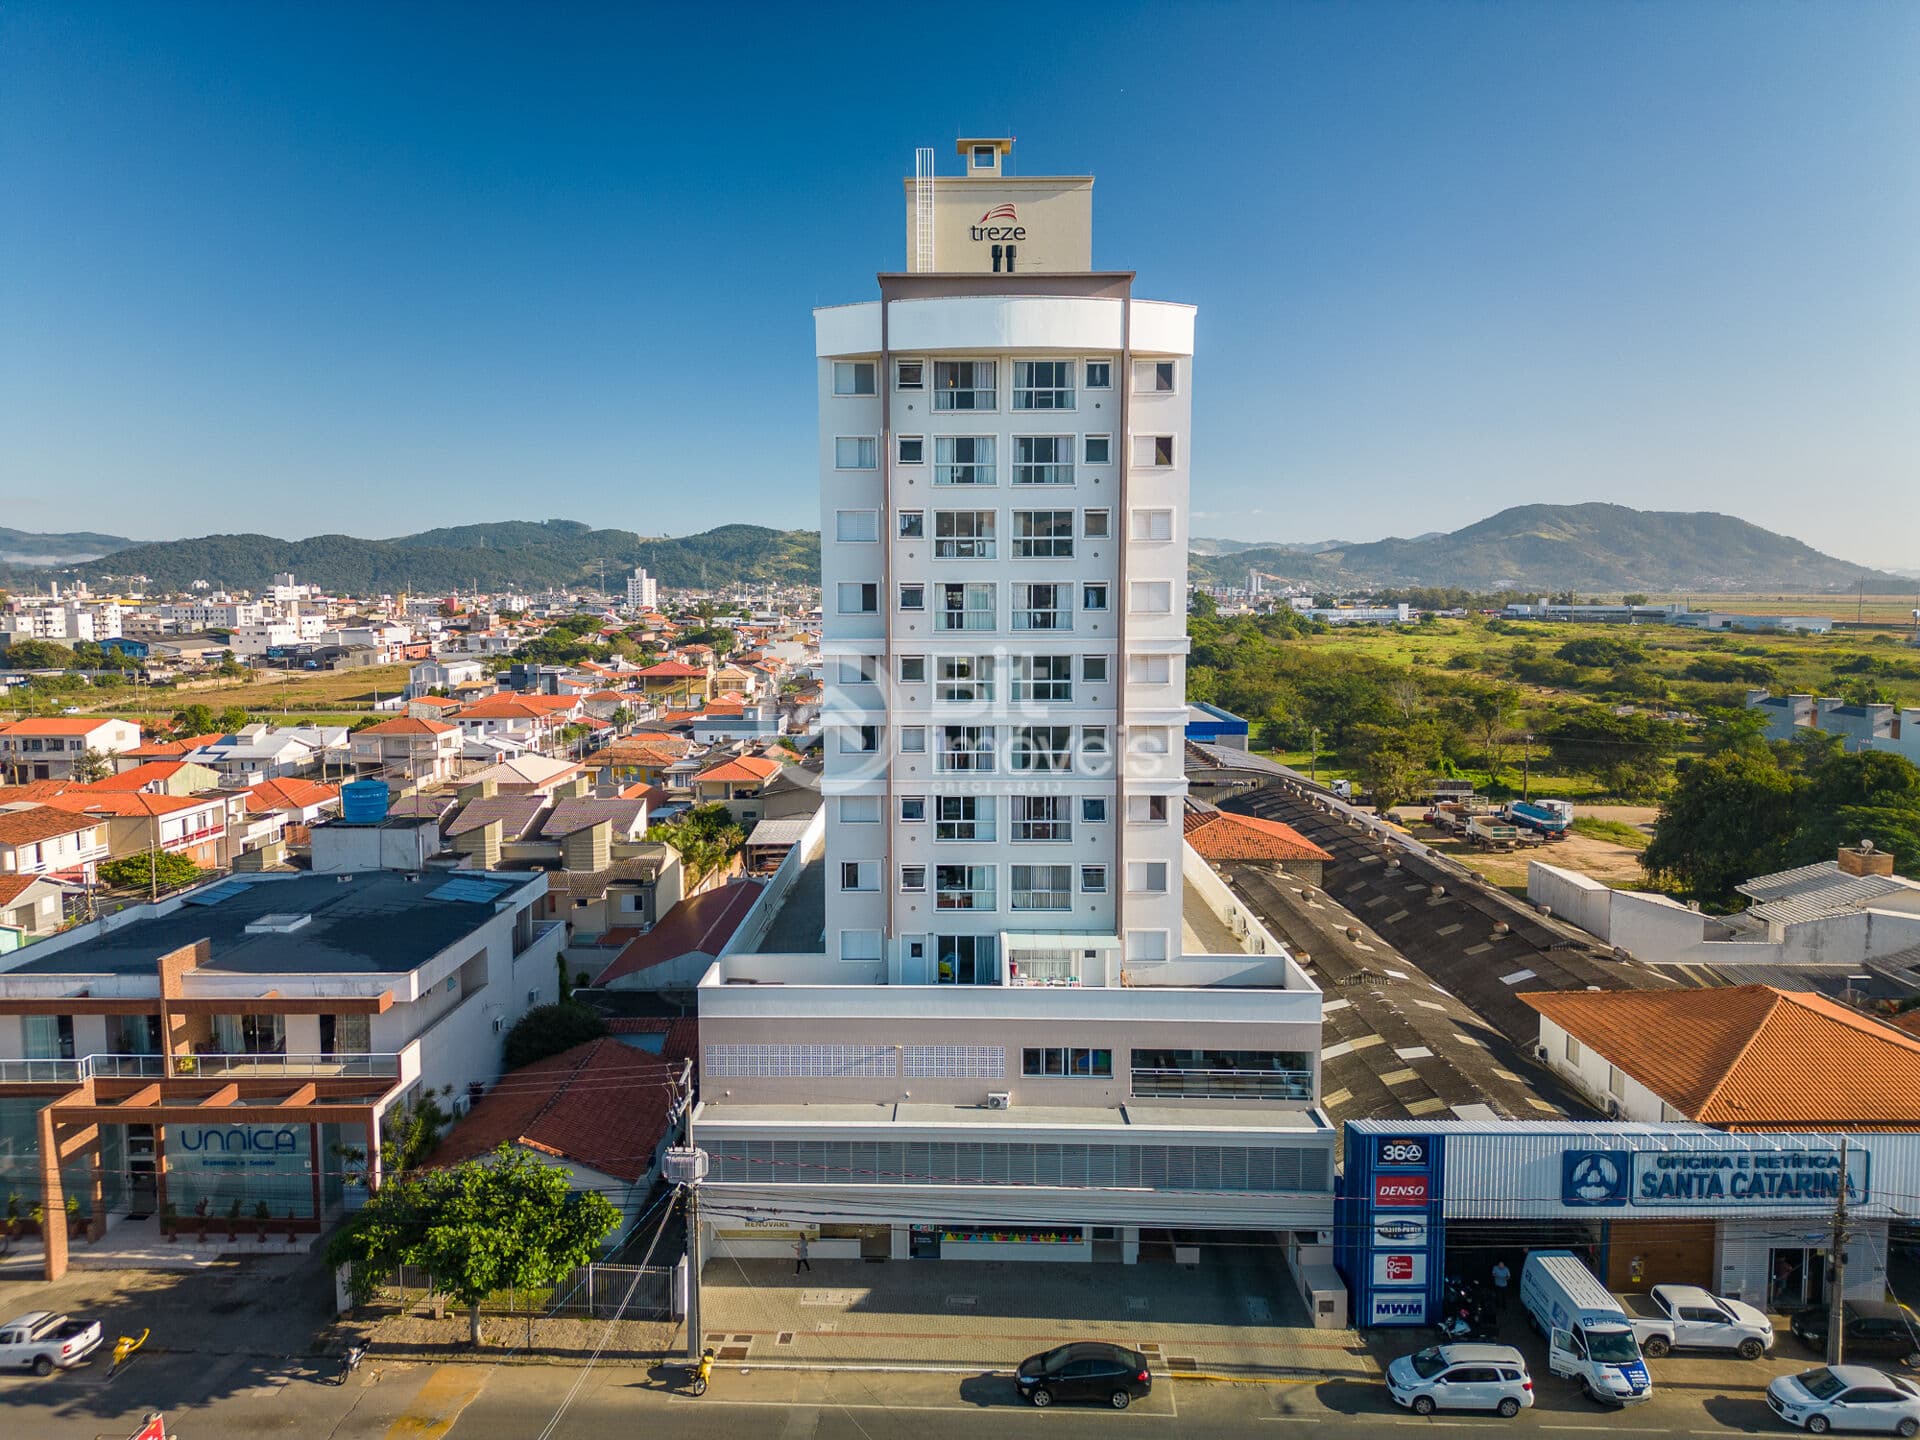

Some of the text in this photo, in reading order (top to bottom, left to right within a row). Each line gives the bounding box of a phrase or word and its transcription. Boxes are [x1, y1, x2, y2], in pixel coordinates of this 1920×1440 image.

[970, 225, 1026, 241] treze
[1656, 1153, 1841, 1169] OFICINA E RETÍFICA
[1380, 1185, 1425, 1196] DENSO
[1641, 1172, 1725, 1199] SANTA
[1376, 1304, 1422, 1314] MWM
